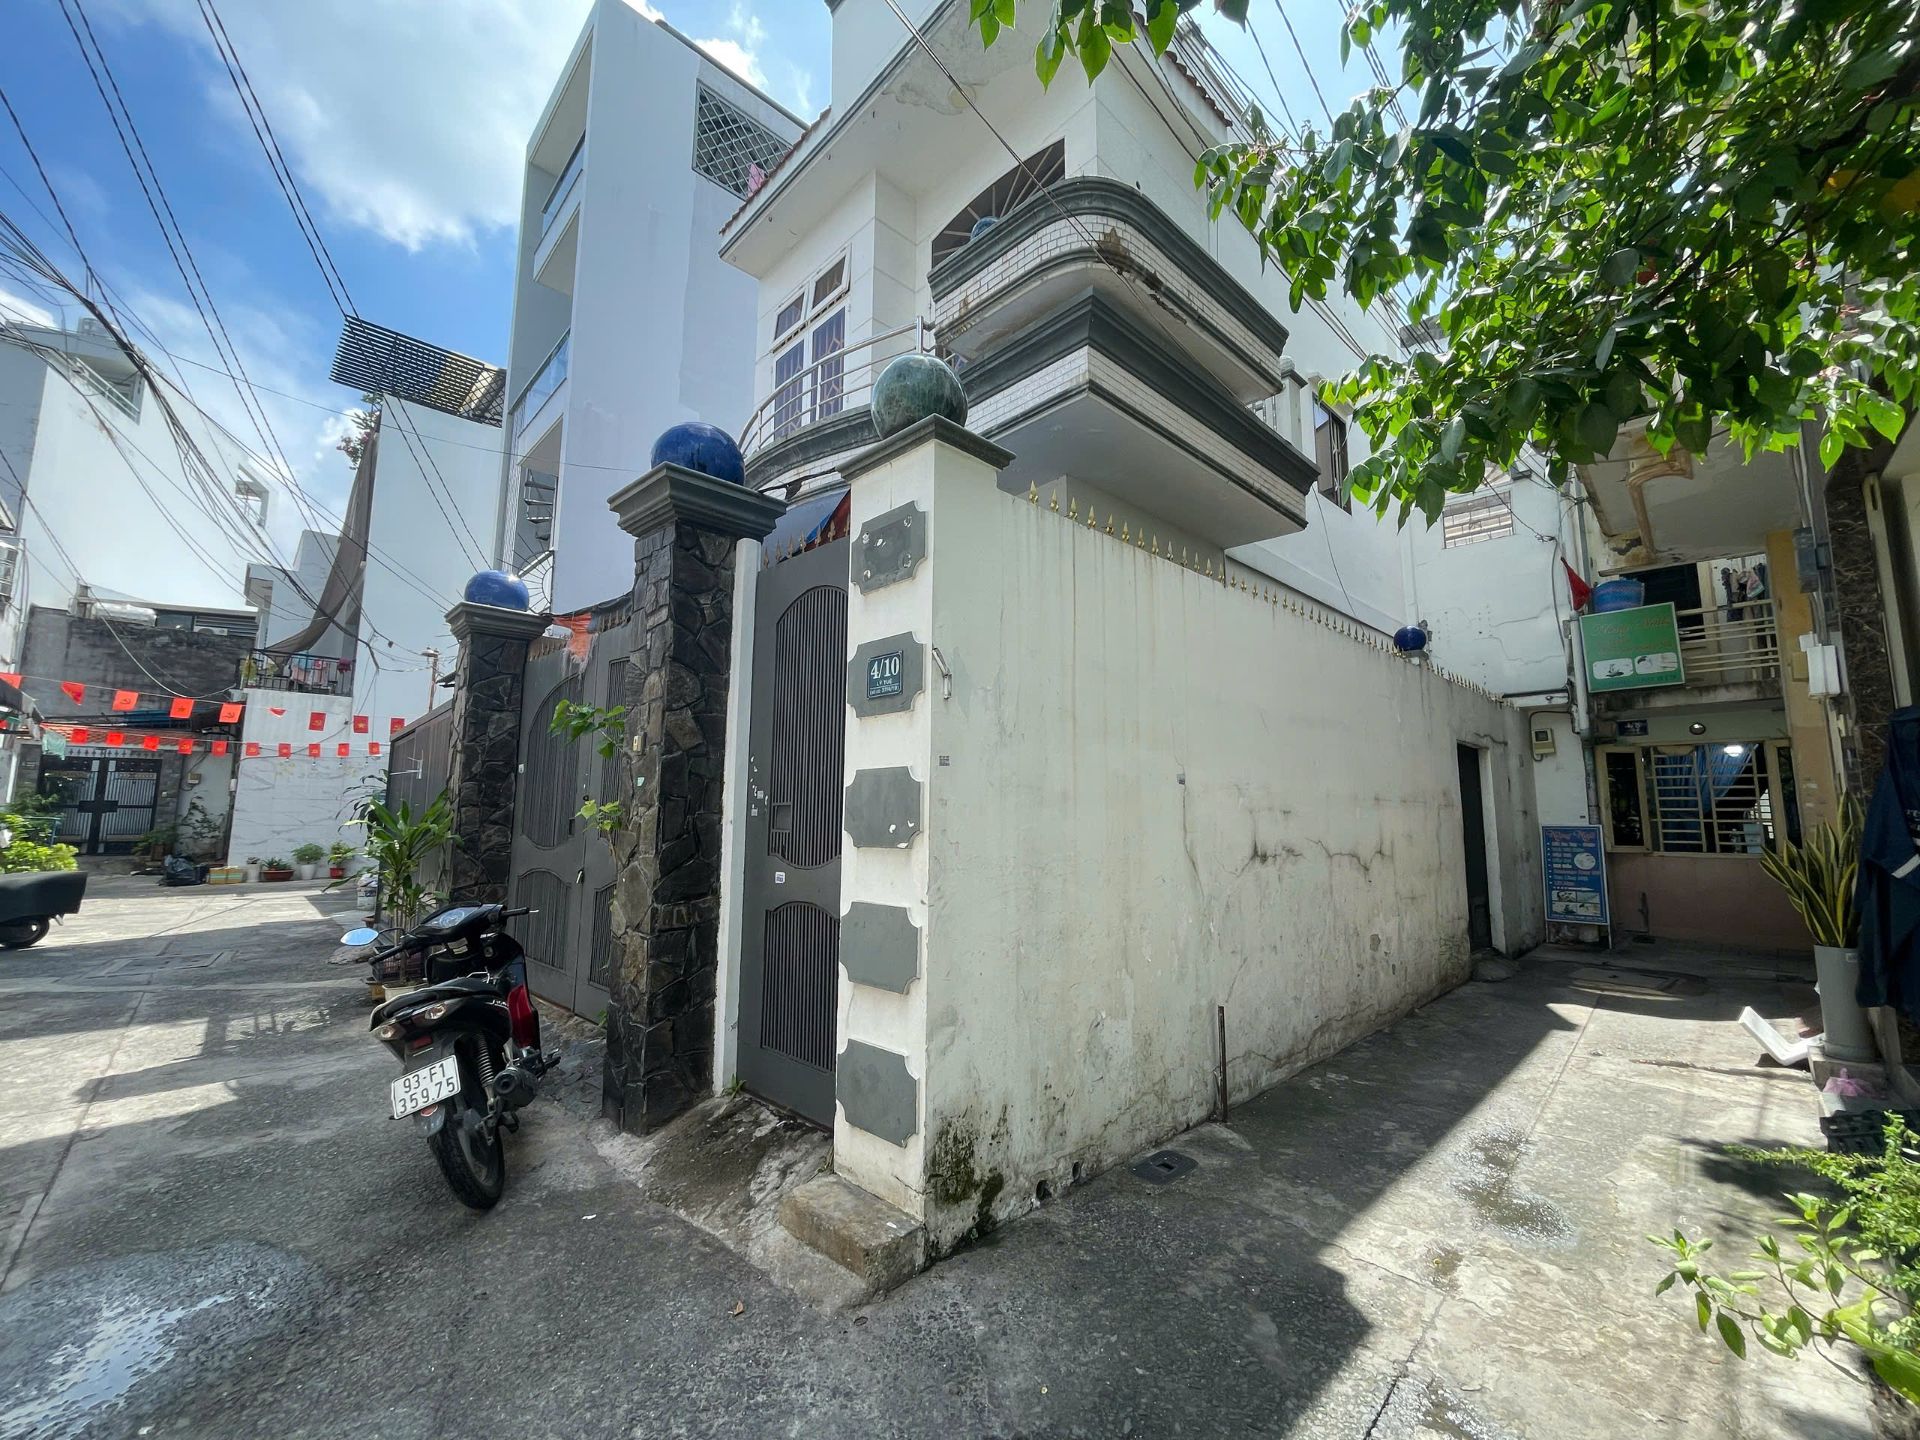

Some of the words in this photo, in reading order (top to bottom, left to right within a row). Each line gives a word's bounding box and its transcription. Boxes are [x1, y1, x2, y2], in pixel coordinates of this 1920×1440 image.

[870, 656, 900, 680] 4/10
[403, 1063, 446, 1094] 93-F1
[398, 1076, 456, 1114] 359.75
